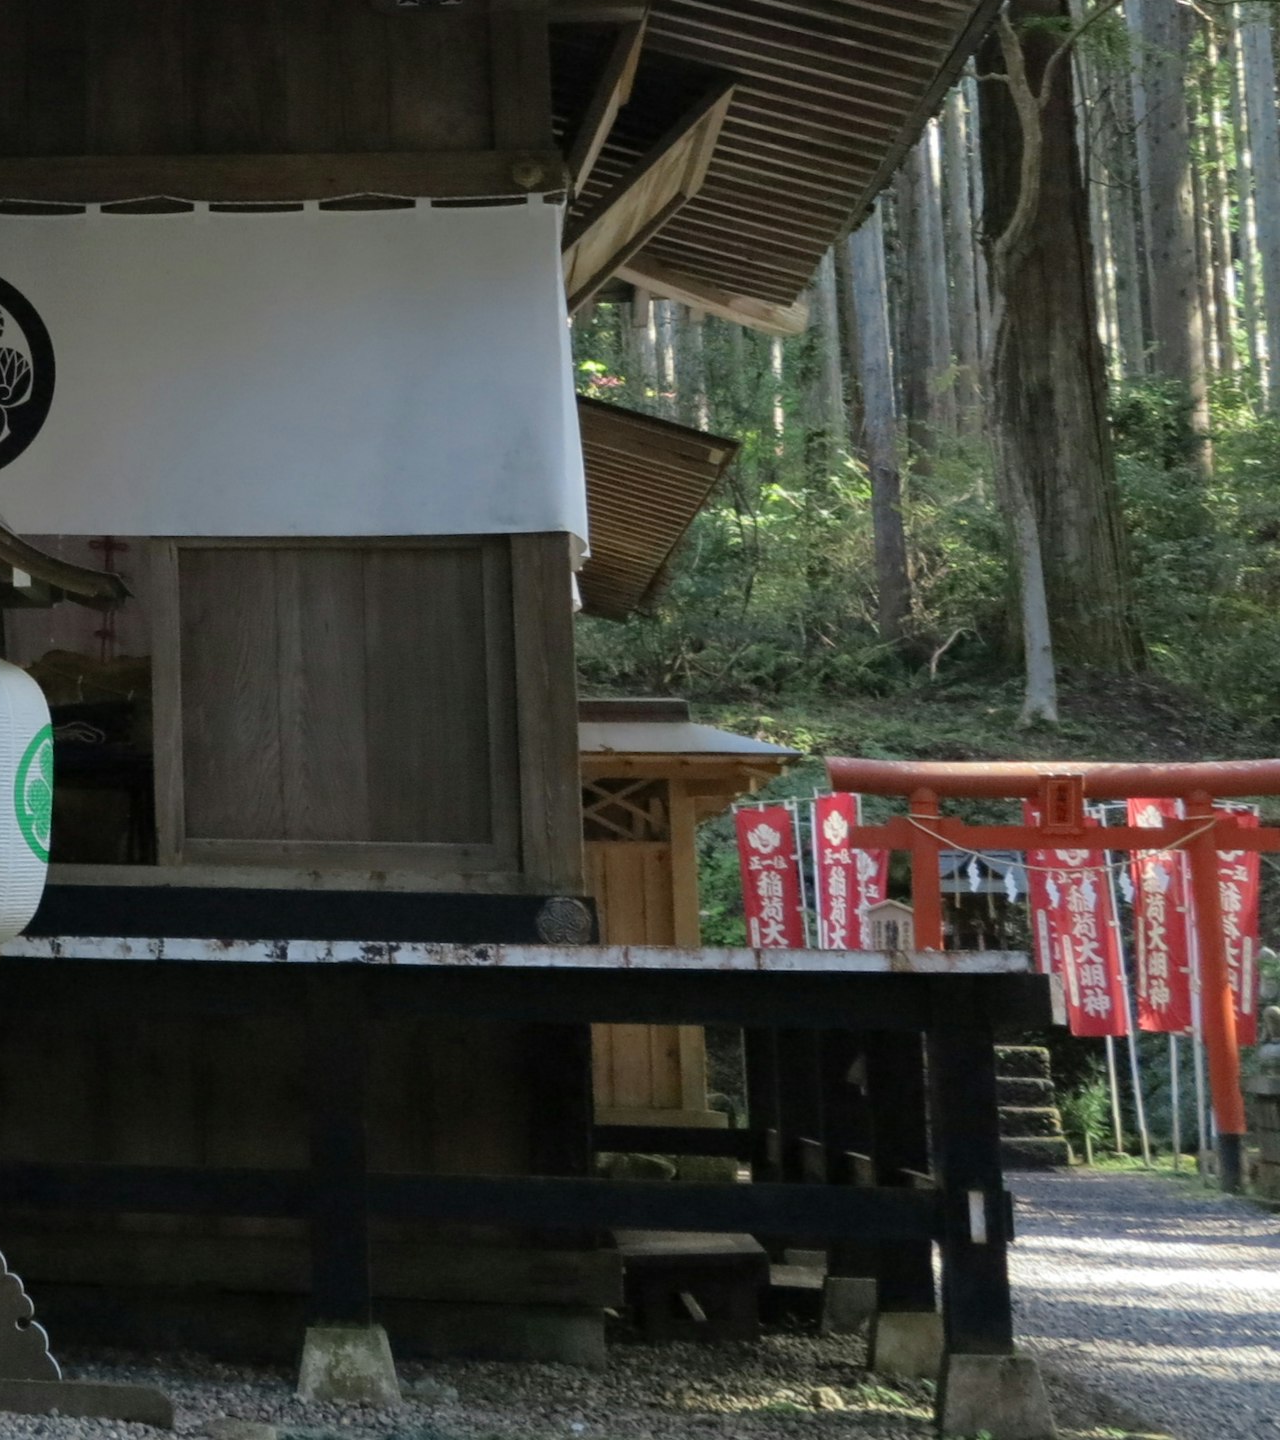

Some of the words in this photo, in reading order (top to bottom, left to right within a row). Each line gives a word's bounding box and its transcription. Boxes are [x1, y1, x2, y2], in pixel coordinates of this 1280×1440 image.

[749, 856, 788, 870] 正一位
[757, 871, 789, 949] 稲荷大
[1066, 886, 1111, 1019] 稲荷大明神
